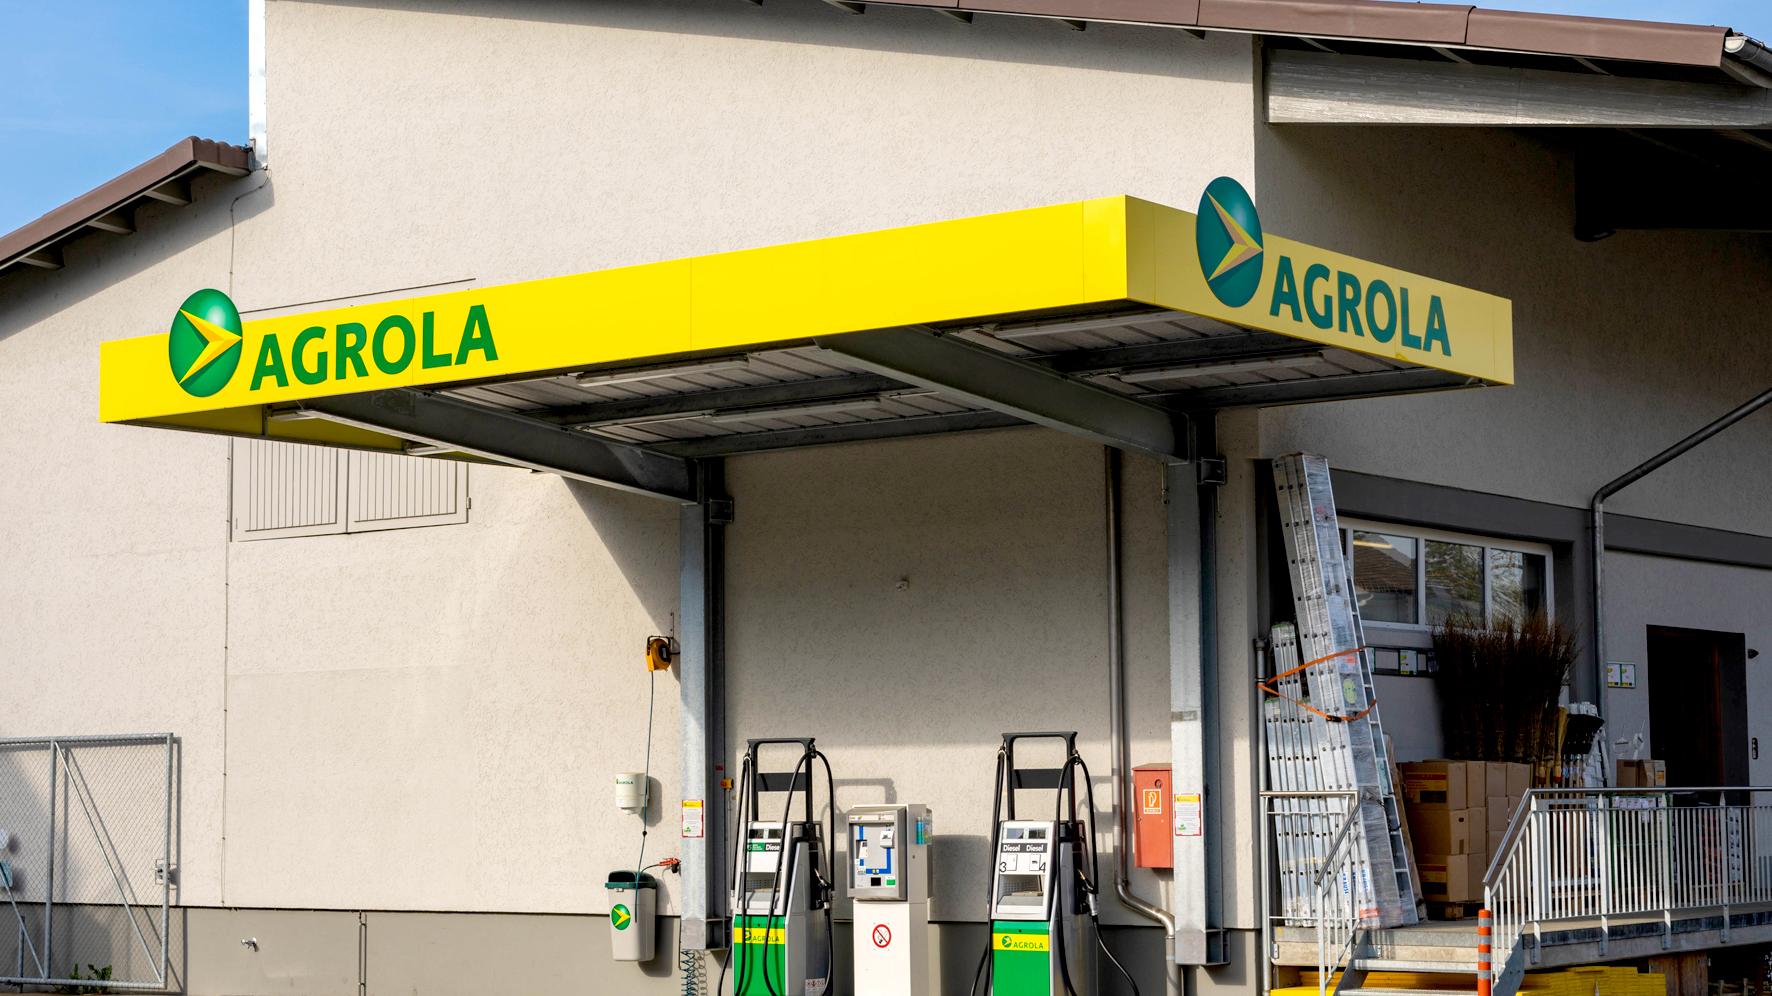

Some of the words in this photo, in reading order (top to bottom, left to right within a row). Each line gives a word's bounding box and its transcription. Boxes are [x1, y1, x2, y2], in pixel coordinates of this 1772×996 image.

[1269, 255, 1452, 357] AGROLA
[249, 304, 499, 391] AGROLA
[765, 843, 782, 851] Diese
[1003, 844, 1020, 852] Diesel
[1026, 844, 1043, 852] Diesel
[999, 861, 1007, 873] 3
[1039, 861, 1046, 873] 4
[1013, 940, 1044, 950] AGROLA
